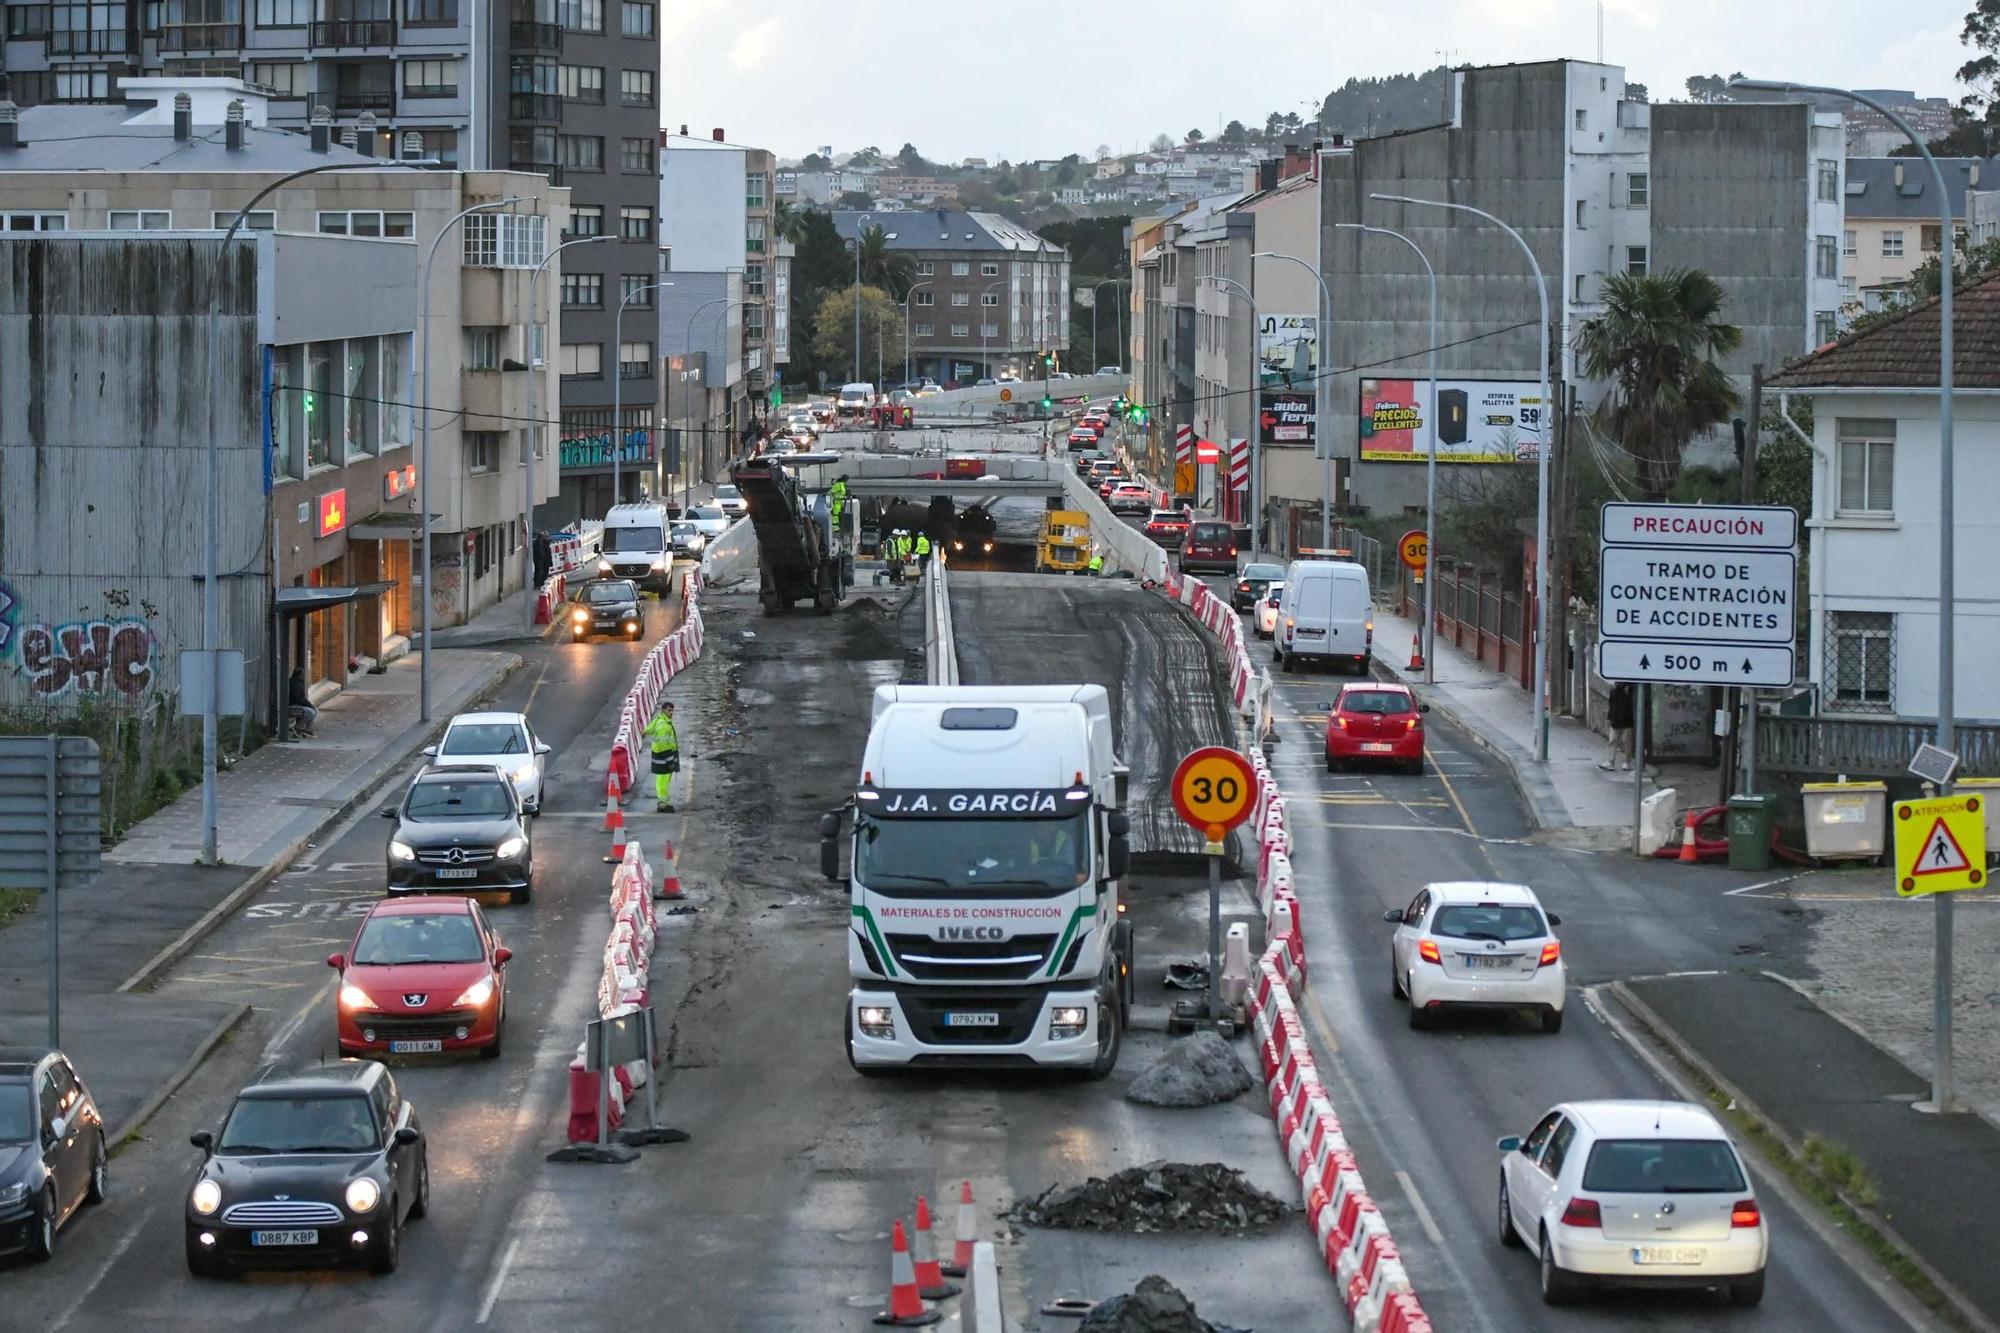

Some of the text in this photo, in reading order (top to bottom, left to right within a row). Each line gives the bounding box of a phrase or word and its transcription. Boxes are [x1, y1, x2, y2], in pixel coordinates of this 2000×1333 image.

[1274, 401, 1307, 411] auto
[1520, 408, 1541, 423] 59
[1373, 419, 1423, 430] EXCELENTES!
[1634, 517, 1763, 536] PRECAUCIÓN
[1408, 544, 1427, 557] 30
[1647, 562, 1750, 580] TRAMO DE
[1610, 585, 1786, 605] CONCENTRACIÓN
[1616, 609, 1778, 629] DE ACCIDENTES
[1664, 655, 1728, 672] 500 m
[1193, 777, 1238, 804] 30
[886, 791, 1057, 812] J.A. GARCÍA
[1914, 802, 1966, 817] ATENCIÓN
[881, 907, 1062, 918] MATERIALES DE CONSTRUCCIÓN
[939, 926, 1004, 940] IVECO
[952, 1015, 975, 1025] 0792
[396, 1041, 440, 1051] 0011 GMJ
[260, 1232, 315, 1244] 0887 KBP
